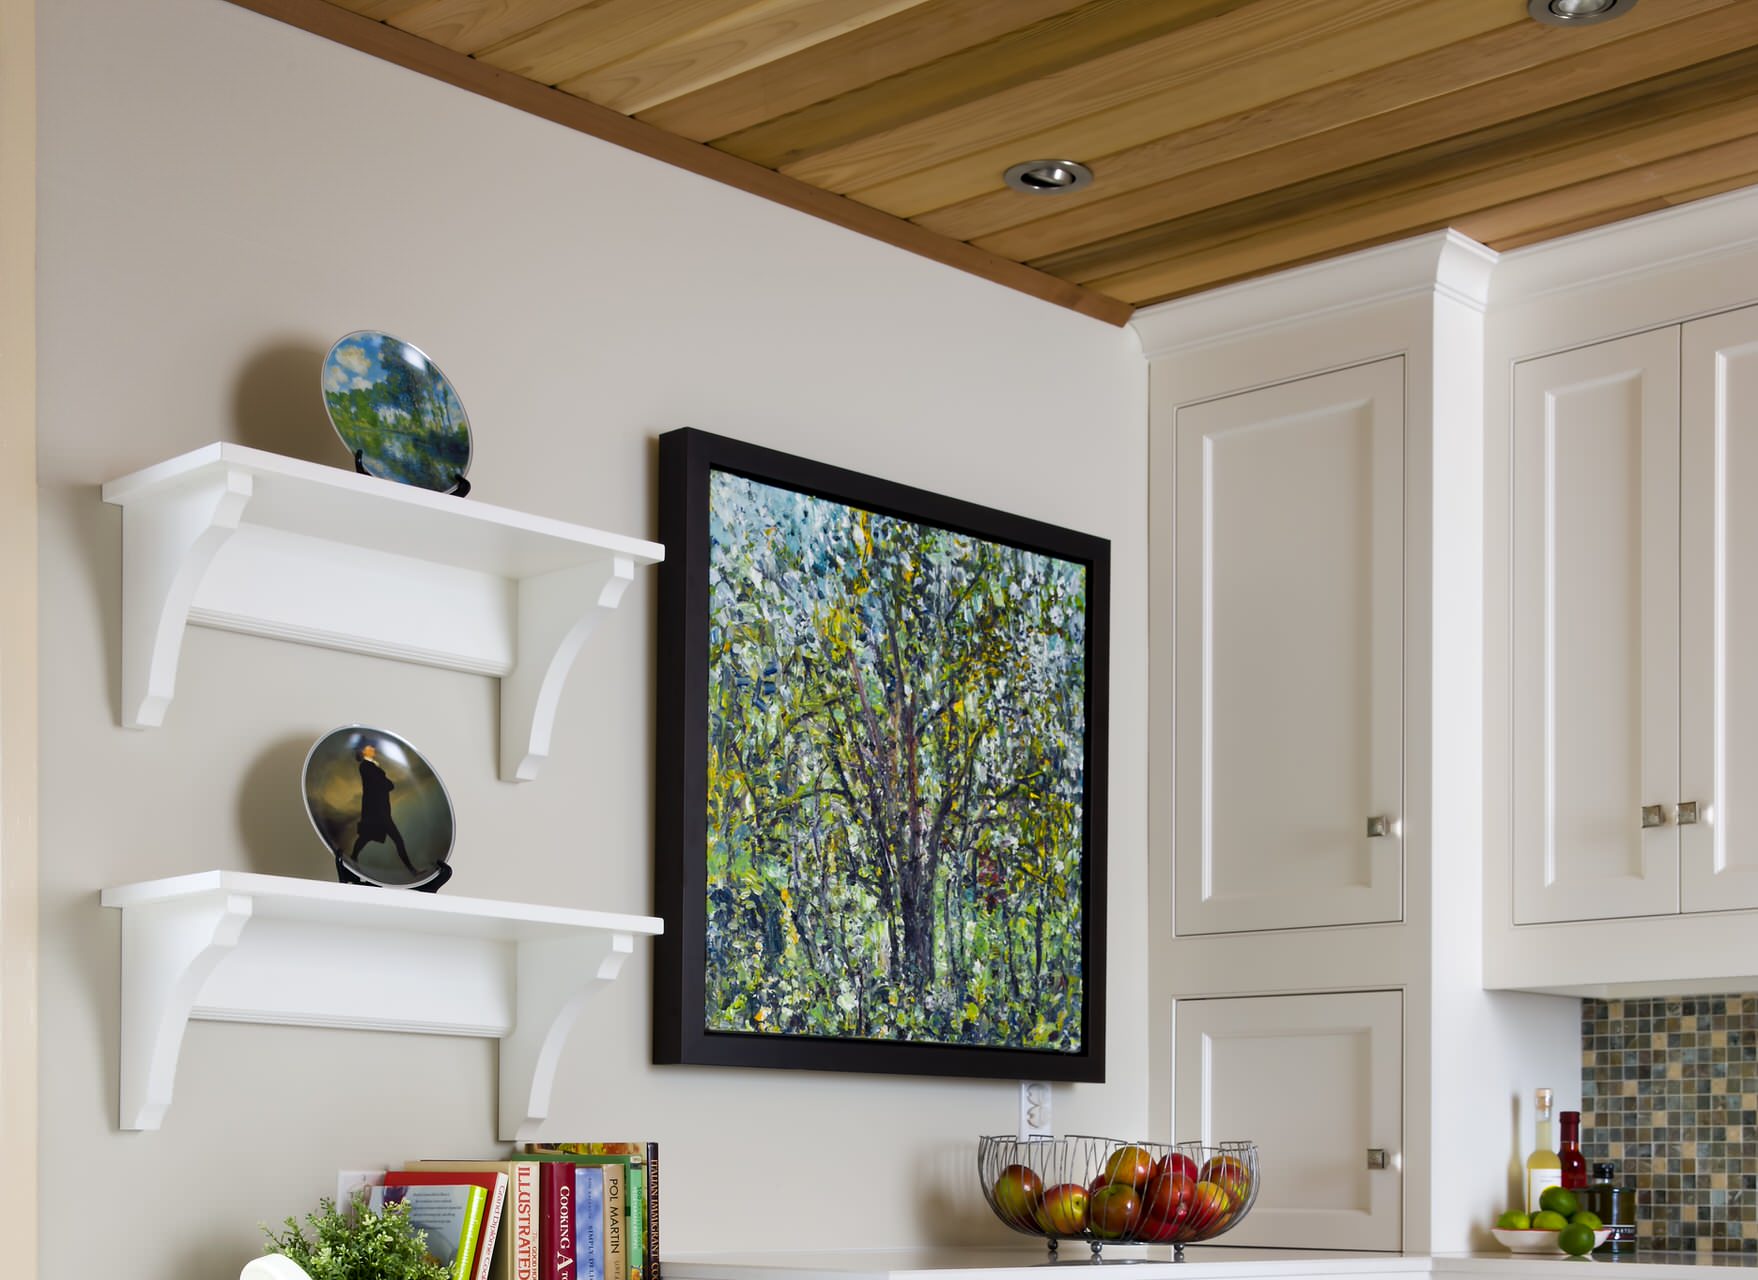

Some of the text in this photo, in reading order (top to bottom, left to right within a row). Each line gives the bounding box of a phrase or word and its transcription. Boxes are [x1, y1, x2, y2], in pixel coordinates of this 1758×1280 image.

[609, 1178, 619, 1201] POL
[651, 1159, 659, 1196] ITALIAN
[518, 1167, 531, 1280] ILLUSTRATED
[560, 1185, 570, 1249] COOKING
[610, 1206, 620, 1254] MARTIN
[651, 1198, 659, 1257] IMMIGRANT
[557, 1250, 574, 1272] A
